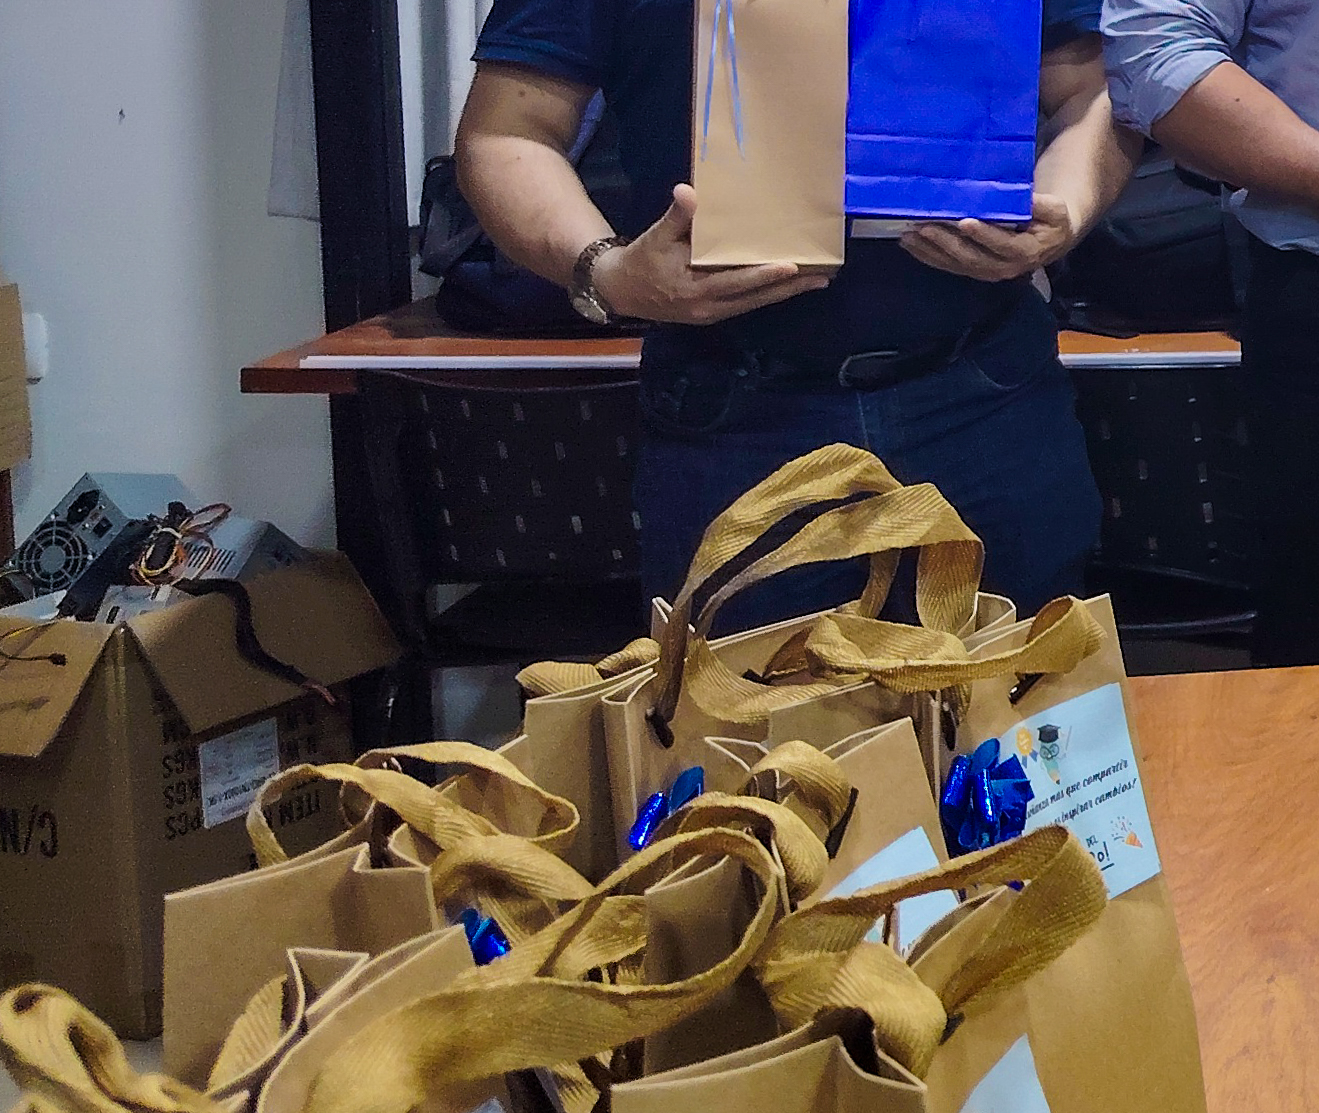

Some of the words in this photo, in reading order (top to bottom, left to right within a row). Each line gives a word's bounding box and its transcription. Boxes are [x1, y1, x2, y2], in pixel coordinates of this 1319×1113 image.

[1066, 781, 1080, 797] que
[1082, 759, 1128, 788] compartir
[1061, 799, 1093, 823] inspirar
[1094, 777, 1137, 806] cambios!
